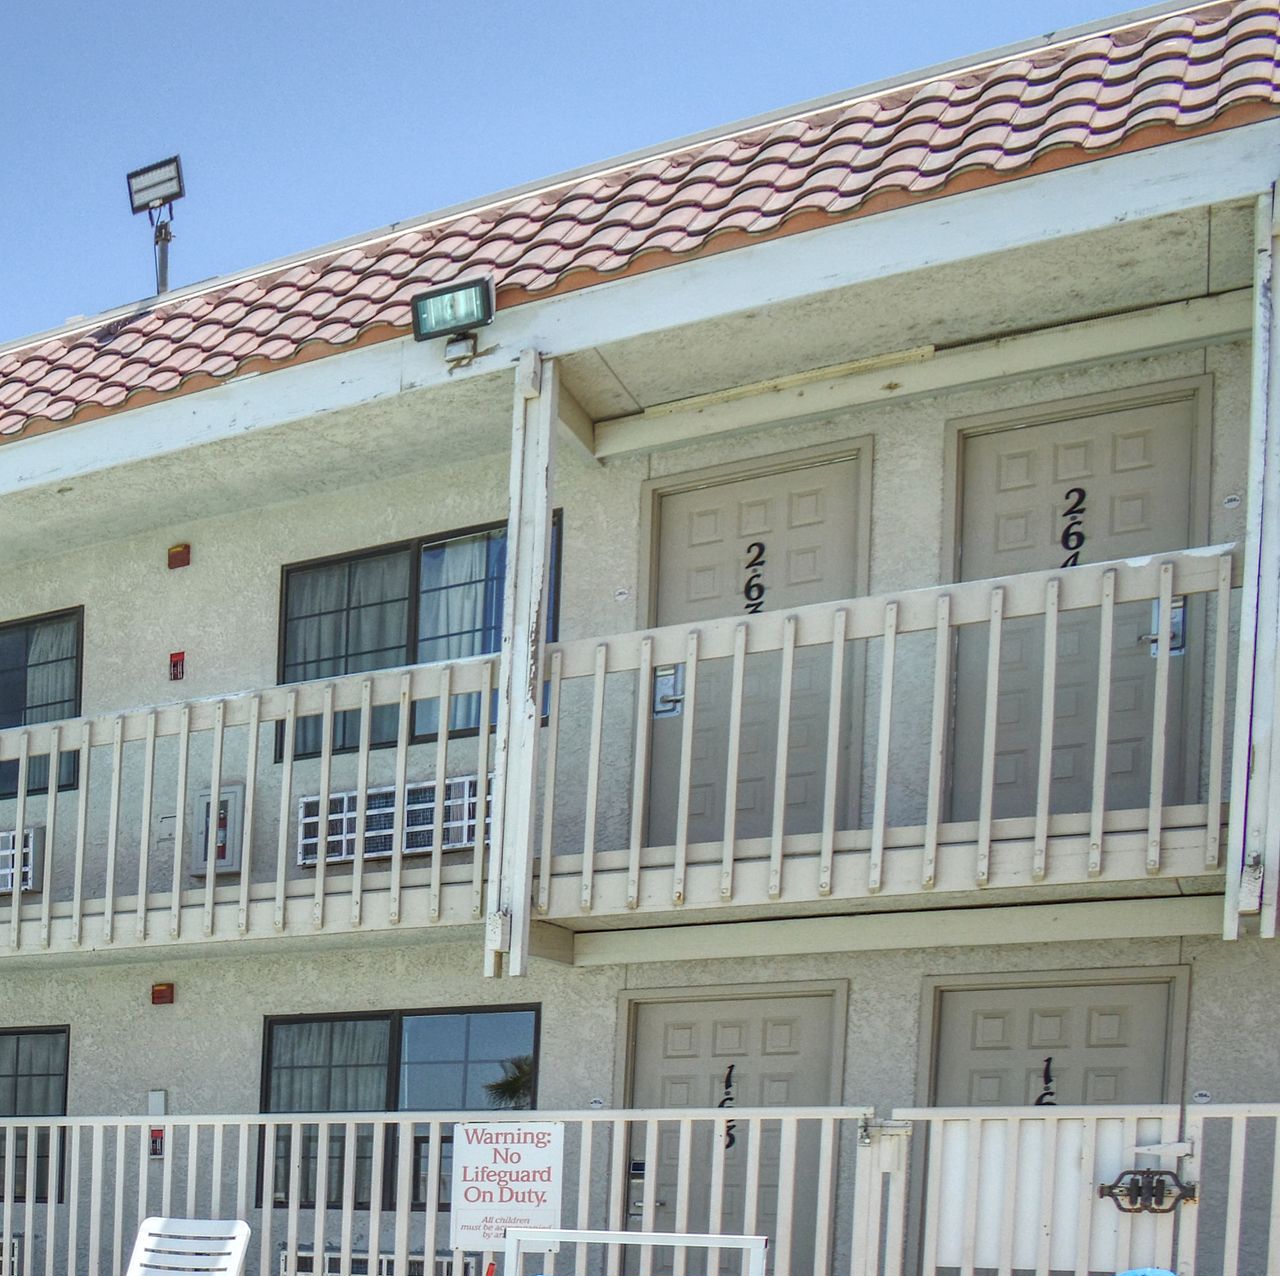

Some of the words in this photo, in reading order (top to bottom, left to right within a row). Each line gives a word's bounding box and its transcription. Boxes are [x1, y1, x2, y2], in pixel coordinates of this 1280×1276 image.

[464, 1128, 552, 1148] Warning:
[492, 1148, 521, 1164] No
[462, 1166, 552, 1186] Lifeguard
[464, 1186, 494, 1203] On
[498, 1186, 547, 1207] Duty.
[481, 1216, 493, 1224] All
[495, 1216, 530, 1224] children
